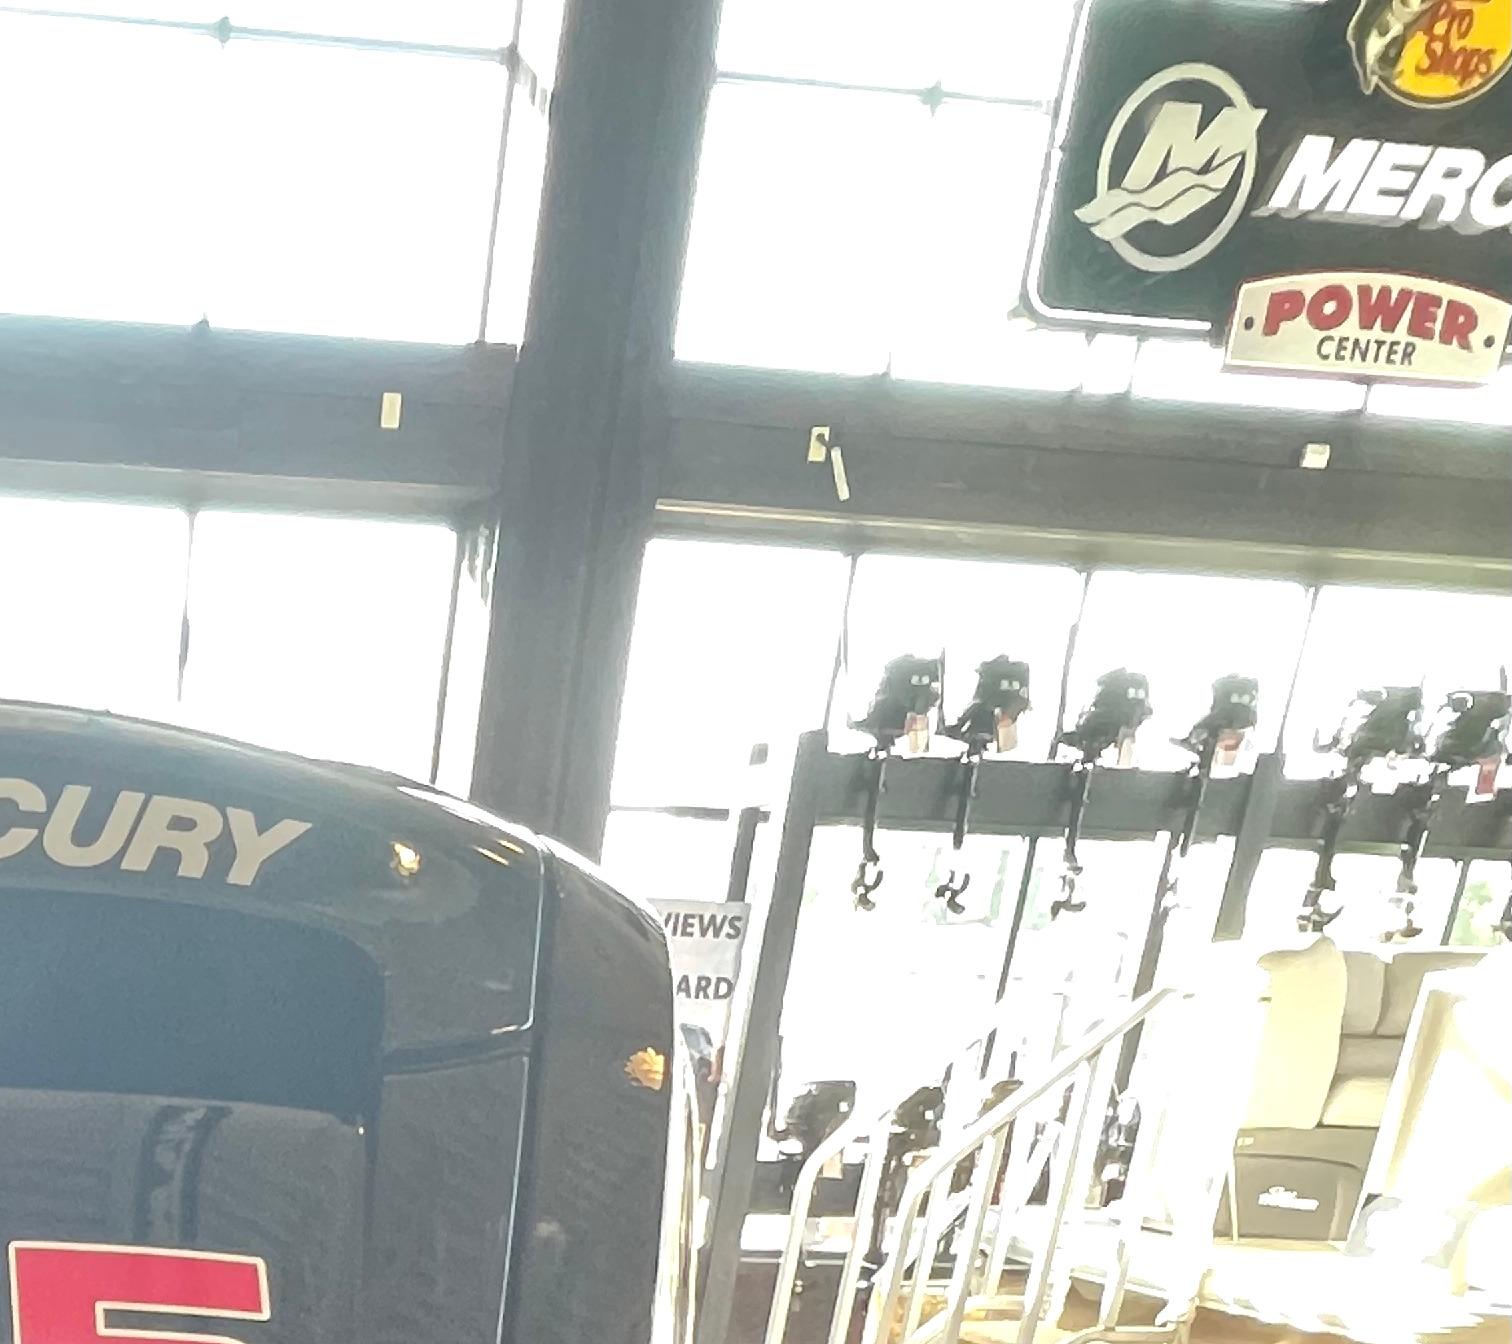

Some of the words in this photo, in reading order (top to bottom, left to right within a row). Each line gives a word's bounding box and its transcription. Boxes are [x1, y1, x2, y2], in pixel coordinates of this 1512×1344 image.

[1415, 38, 1497, 87] Shops
[1261, 284, 1478, 352] POWER
[1316, 335, 1417, 365] CENTER
